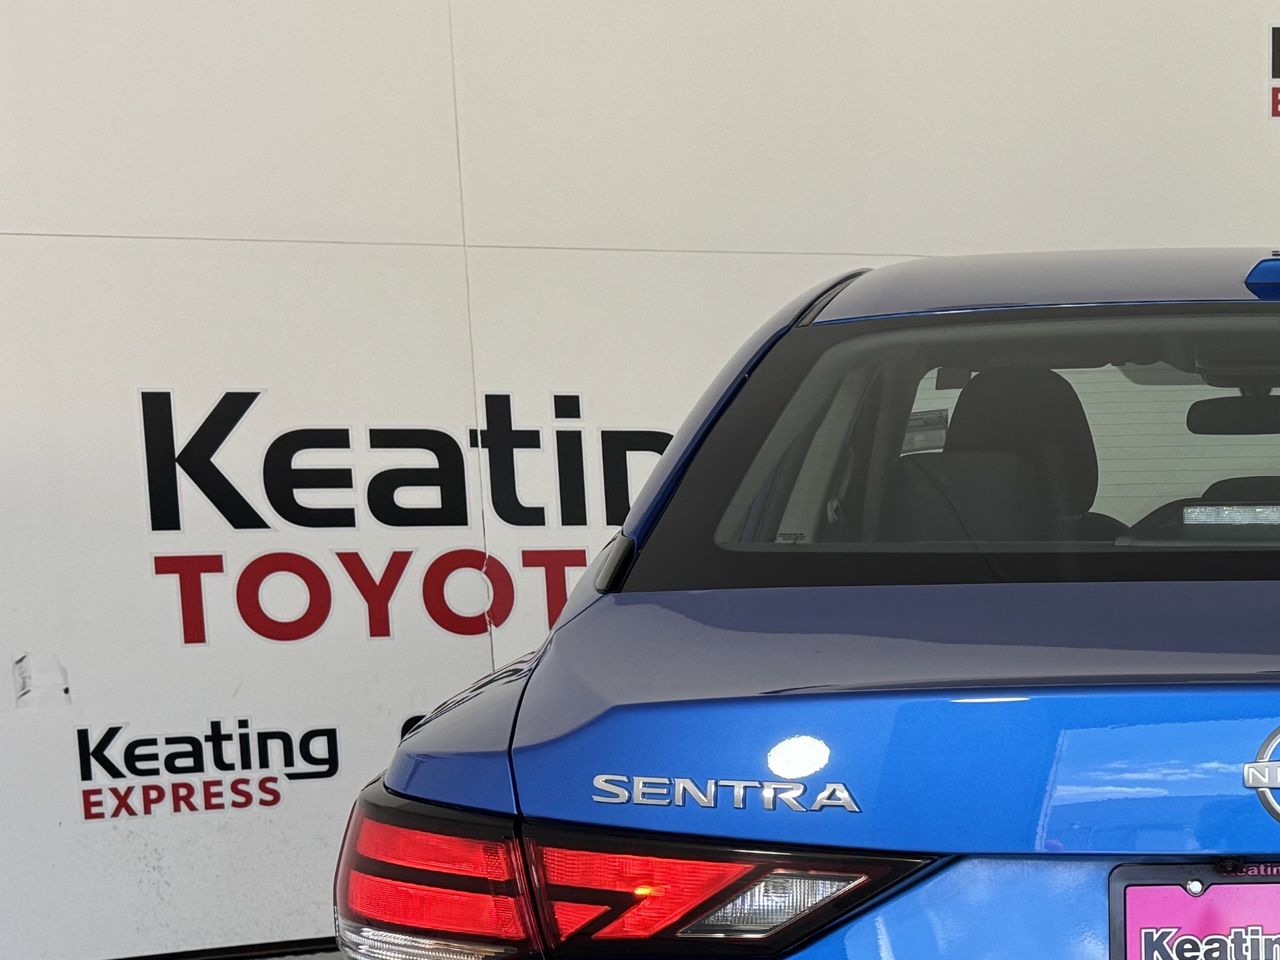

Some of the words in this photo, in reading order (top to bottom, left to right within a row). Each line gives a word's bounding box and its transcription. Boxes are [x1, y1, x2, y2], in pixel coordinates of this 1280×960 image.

[141, 391, 674, 531] Keatin
[154, 548, 588, 644] TOYOT
[76, 718, 339, 780] Keating
[82, 776, 282, 820] EXPRESS
[591, 774, 862, 812] SENTRA
